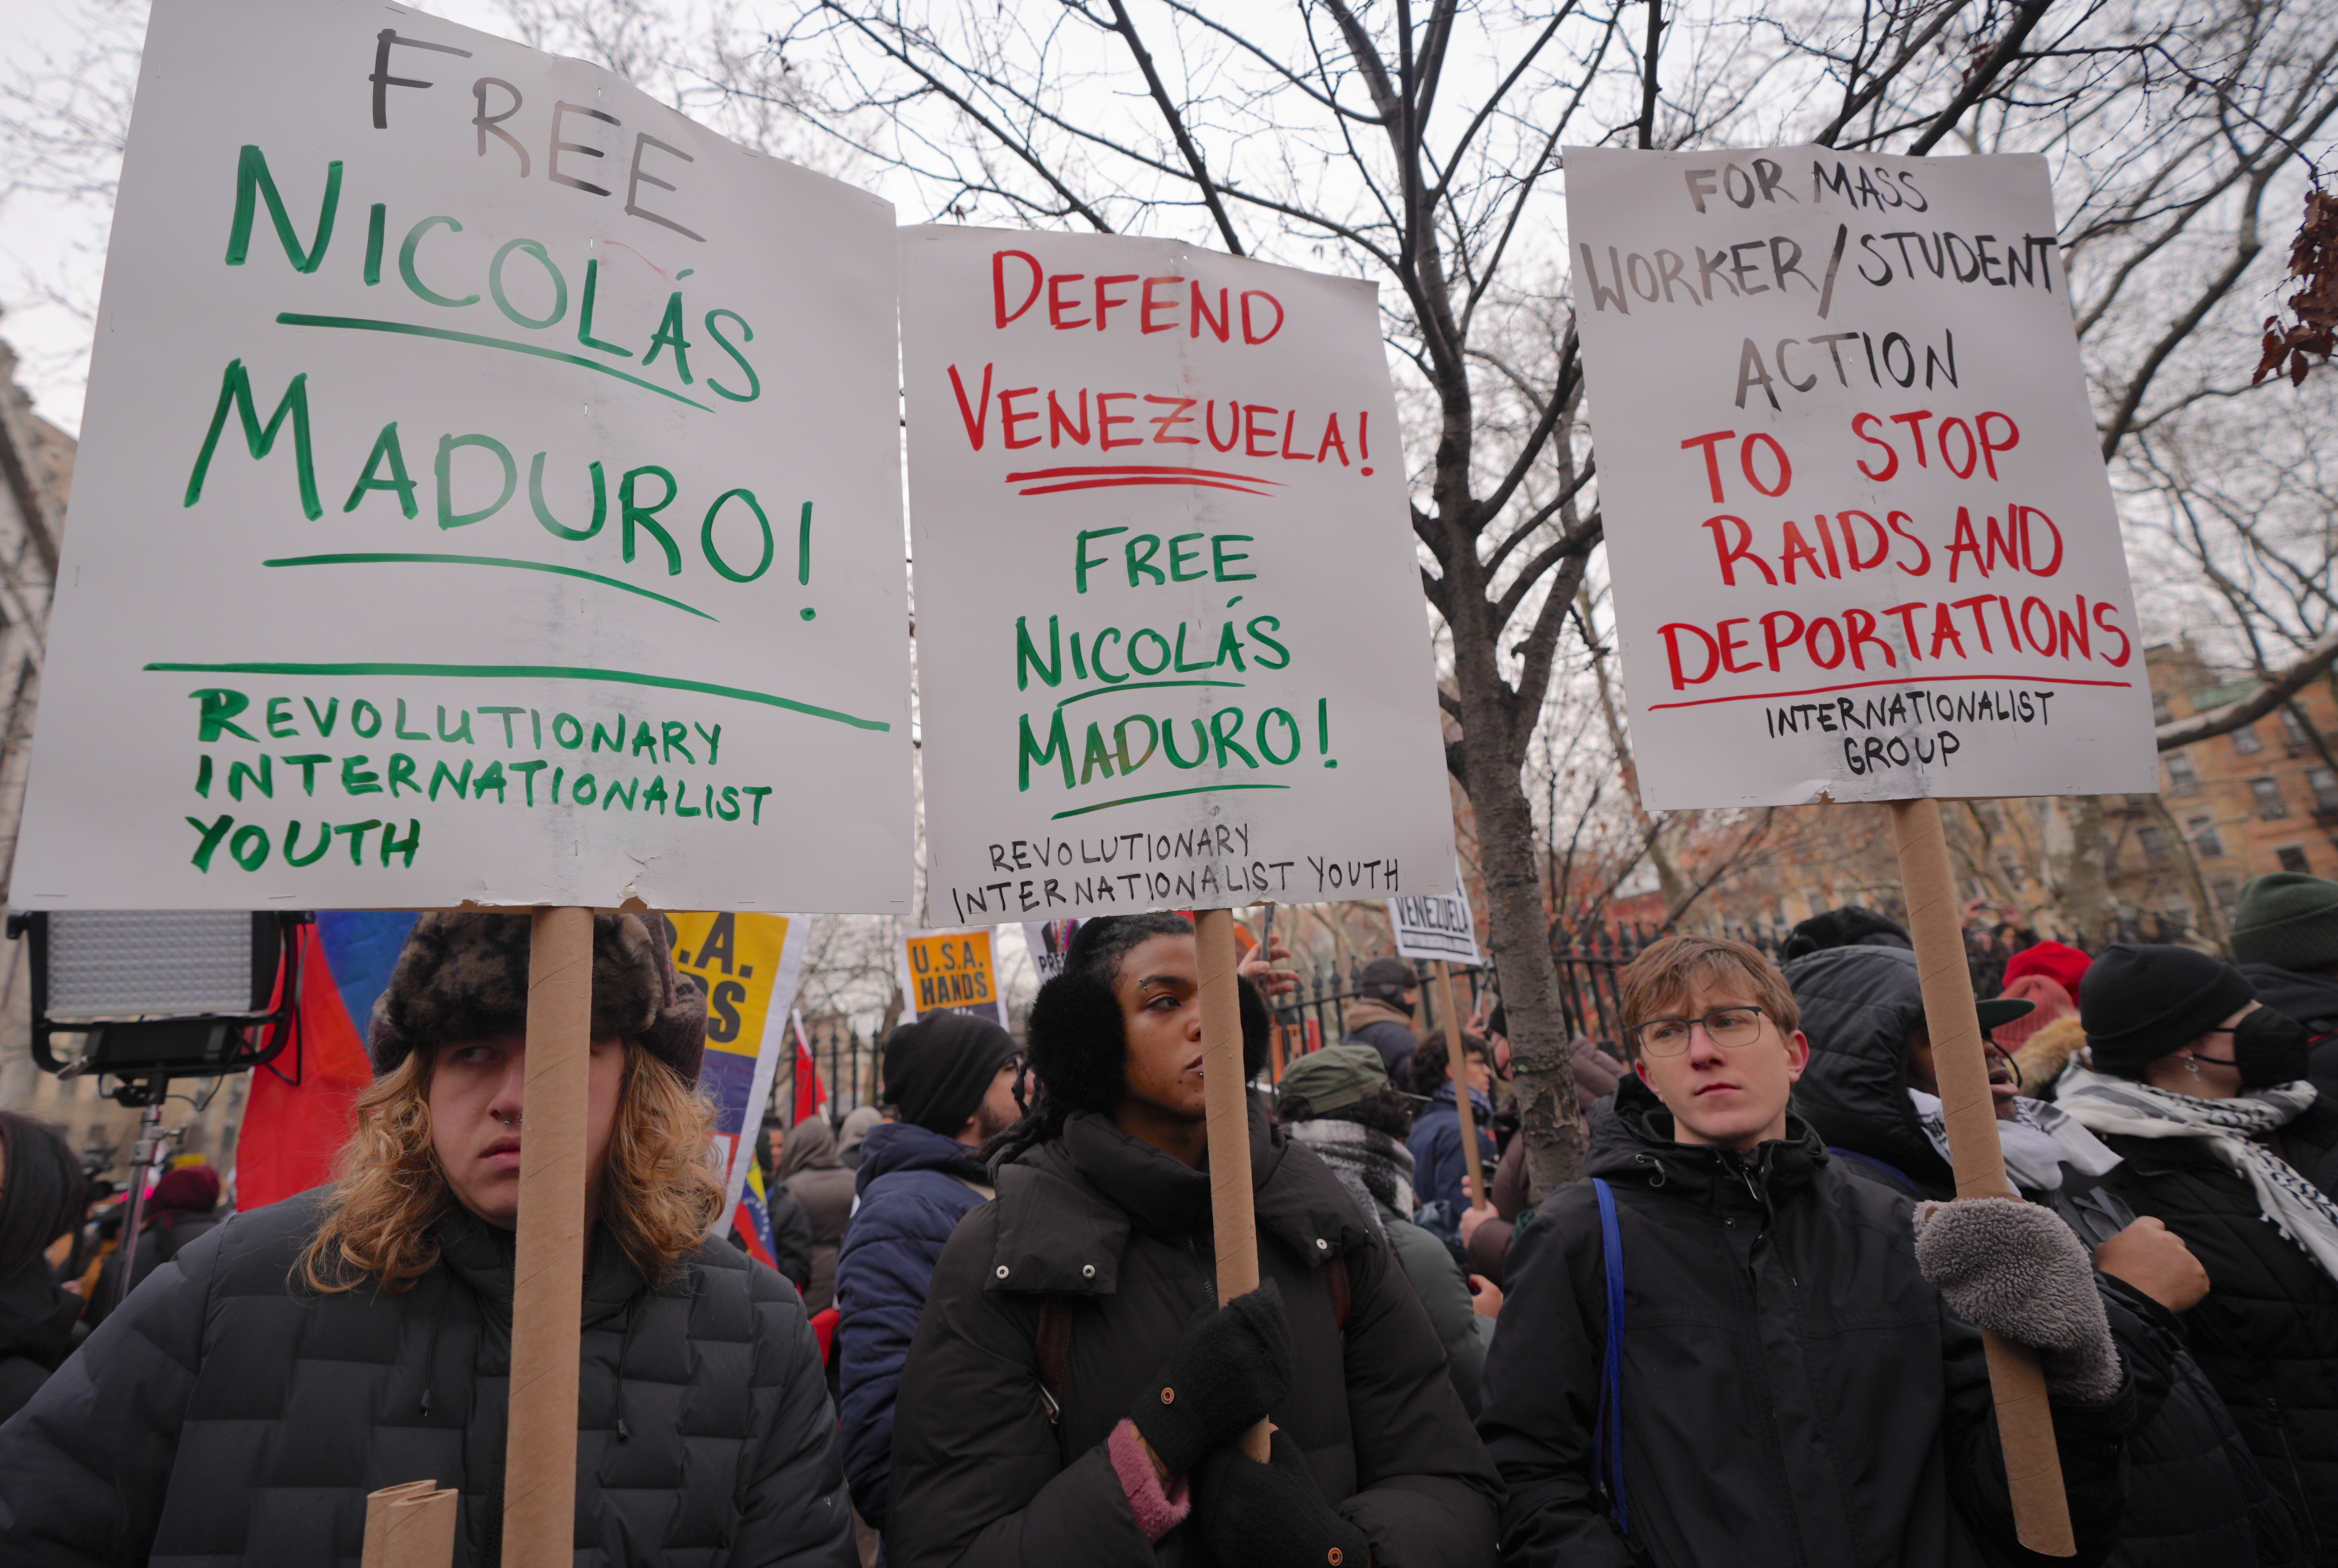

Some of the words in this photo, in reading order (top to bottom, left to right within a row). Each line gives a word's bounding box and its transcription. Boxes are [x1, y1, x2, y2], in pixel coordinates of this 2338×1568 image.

[368, 28, 707, 242] FREE
[1685, 158, 1799, 214] FOR
[1812, 160, 1929, 213] MASS
[224, 144, 761, 403] NICOLÁS
[992, 249, 1285, 345] DEFEND
[1579, 223, 2058, 320] WORKER/STUDENT
[1734, 328, 1959, 413] ACTION
[947, 362, 1374, 477] VENEZUELA!
[1680, 429, 1792, 504] TO
[1851, 409, 2020, 482] STOP
[183, 357, 817, 622] MADURO!
[1075, 526, 1258, 595] FREE
[1701, 509, 1931, 587] RAIDS
[1944, 503, 2064, 584] AND
[1015, 595, 1291, 692] NICOLÁS
[1656, 593, 2131, 691] DEPORTATIONS
[188, 688, 722, 766] REVOLUTIONARY
[1018, 697, 1339, 793] MADURO!
[1765, 689, 2055, 739] INTERNATIONALIST
[1844, 731, 1960, 775] GROUP
[194, 752, 773, 826] INTERNATIONALIST
[184, 814, 421, 874] YOUTH
[989, 823, 1248, 873] REVOLUTIONARY
[952, 861, 1295, 924] INTERNATIONALIST
[1307, 856, 1399, 893] YOUTH
[913, 941, 984, 973] U.S.A.
[920, 971, 988, 1006] HANDS
